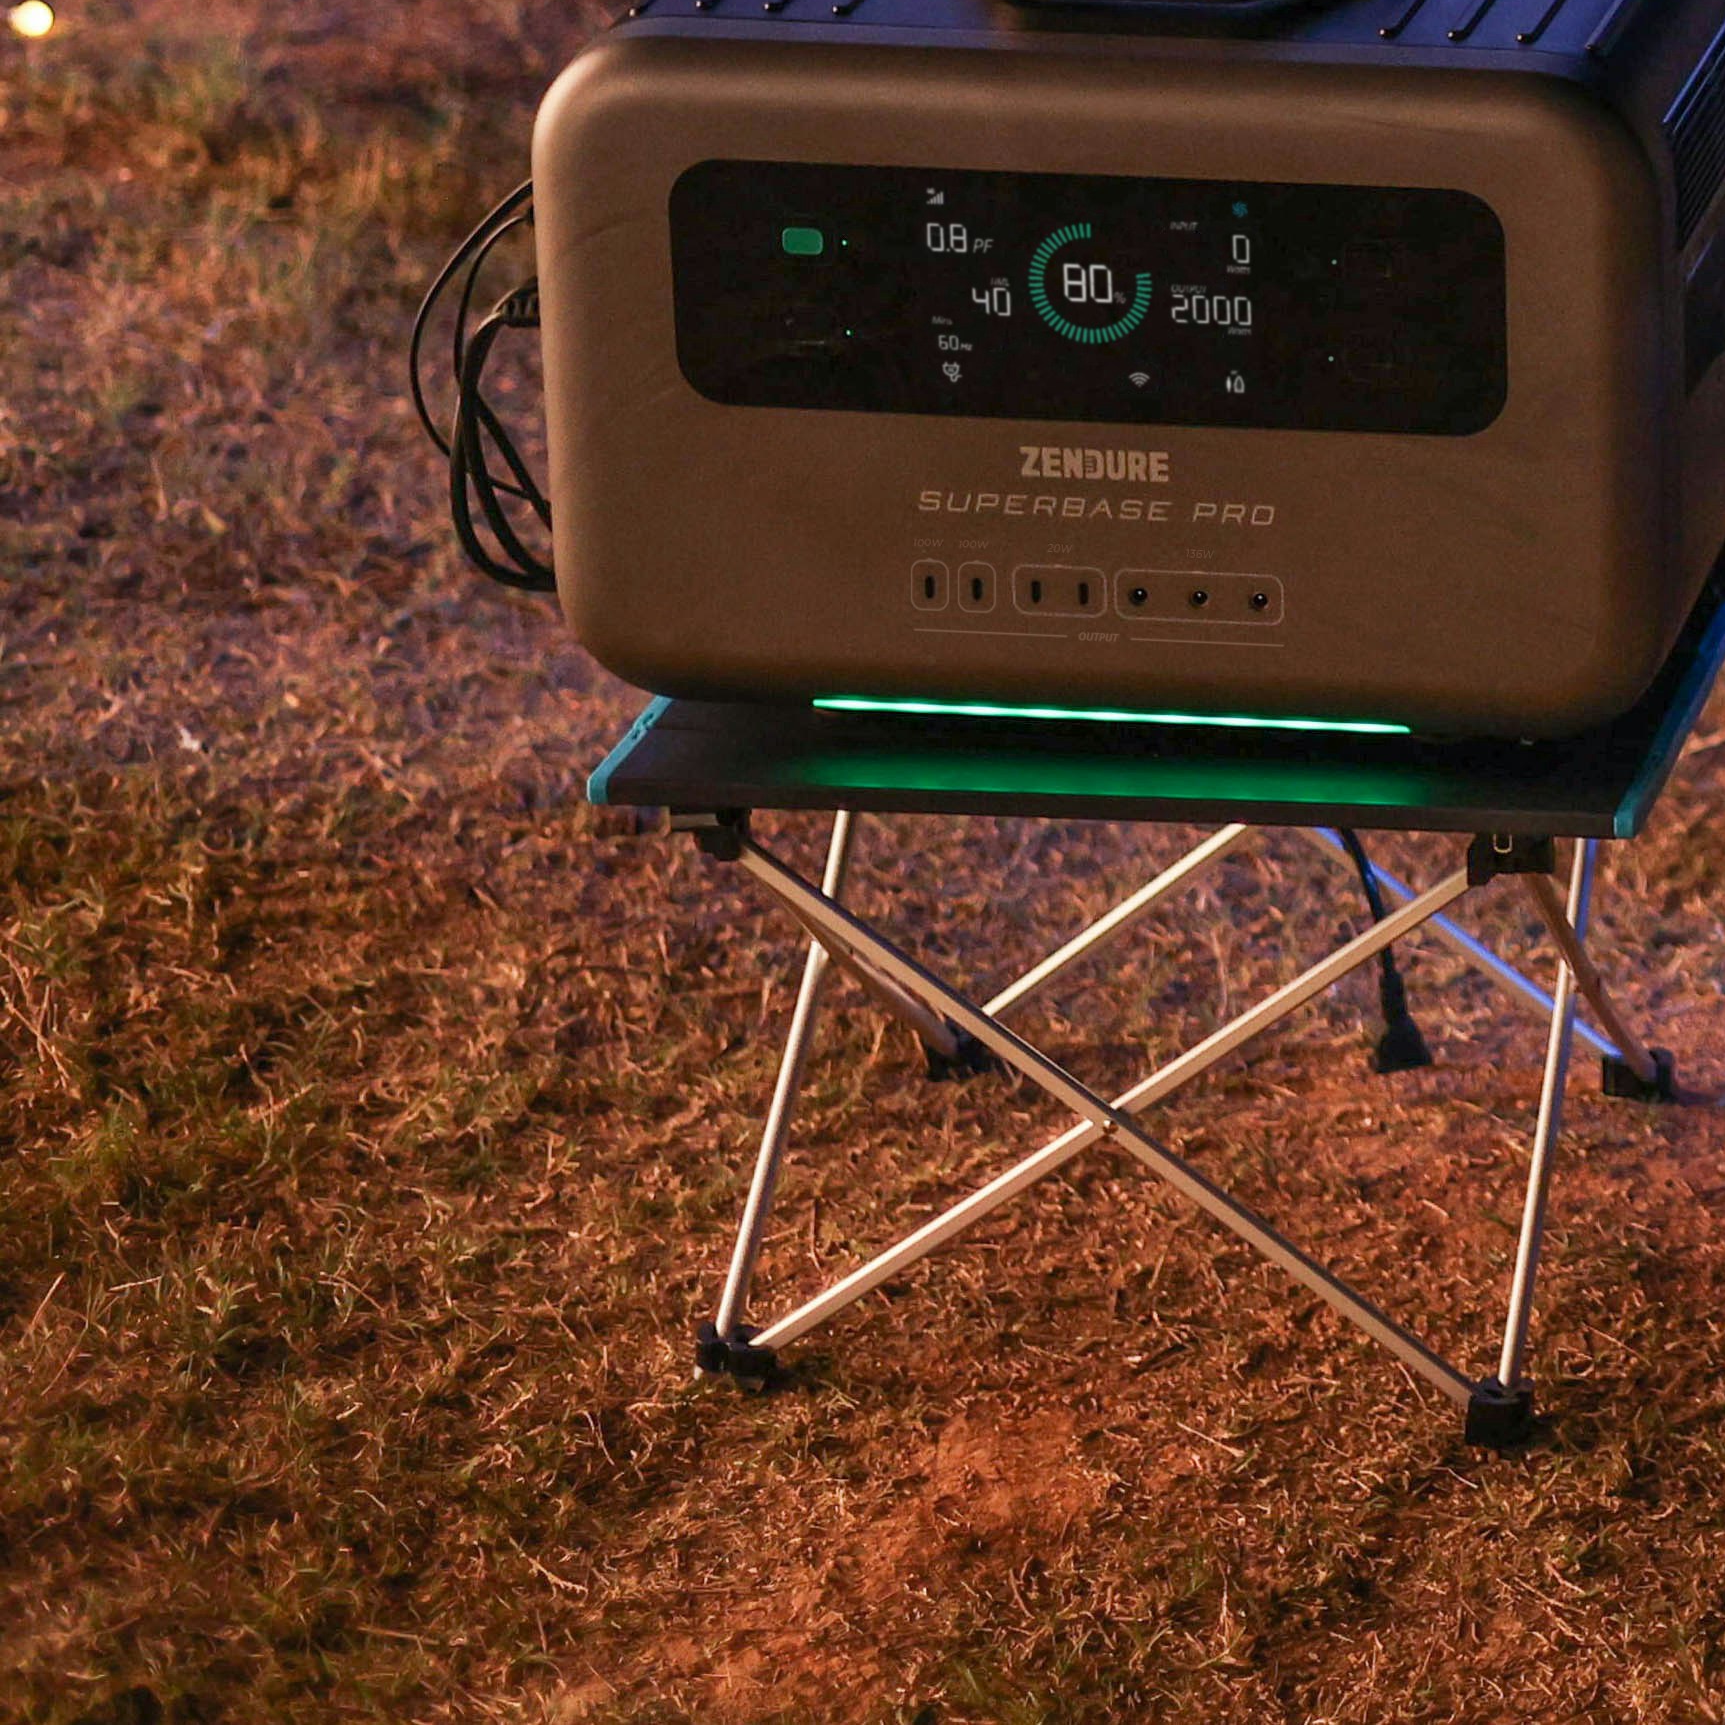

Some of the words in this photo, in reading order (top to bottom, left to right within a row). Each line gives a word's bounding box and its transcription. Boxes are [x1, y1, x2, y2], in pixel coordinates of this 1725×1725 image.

[926, 223, 967, 253] 0.8
[973, 238, 994, 254] PF
[1232, 234, 1250, 264] 0
[972, 287, 1011, 317] 40
[1171, 294, 1252, 325] 2000
[1019, 446, 1169, 482] ZENDURE
[917, 490, 1173, 522] SUPERBASE
[1191, 502, 1276, 526] PRO
[912, 538, 944, 548] 100W
[958, 539, 989, 549] 100W
[1047, 543, 1074, 554] 20W
[1078, 631, 1119, 643] OUTPUT
